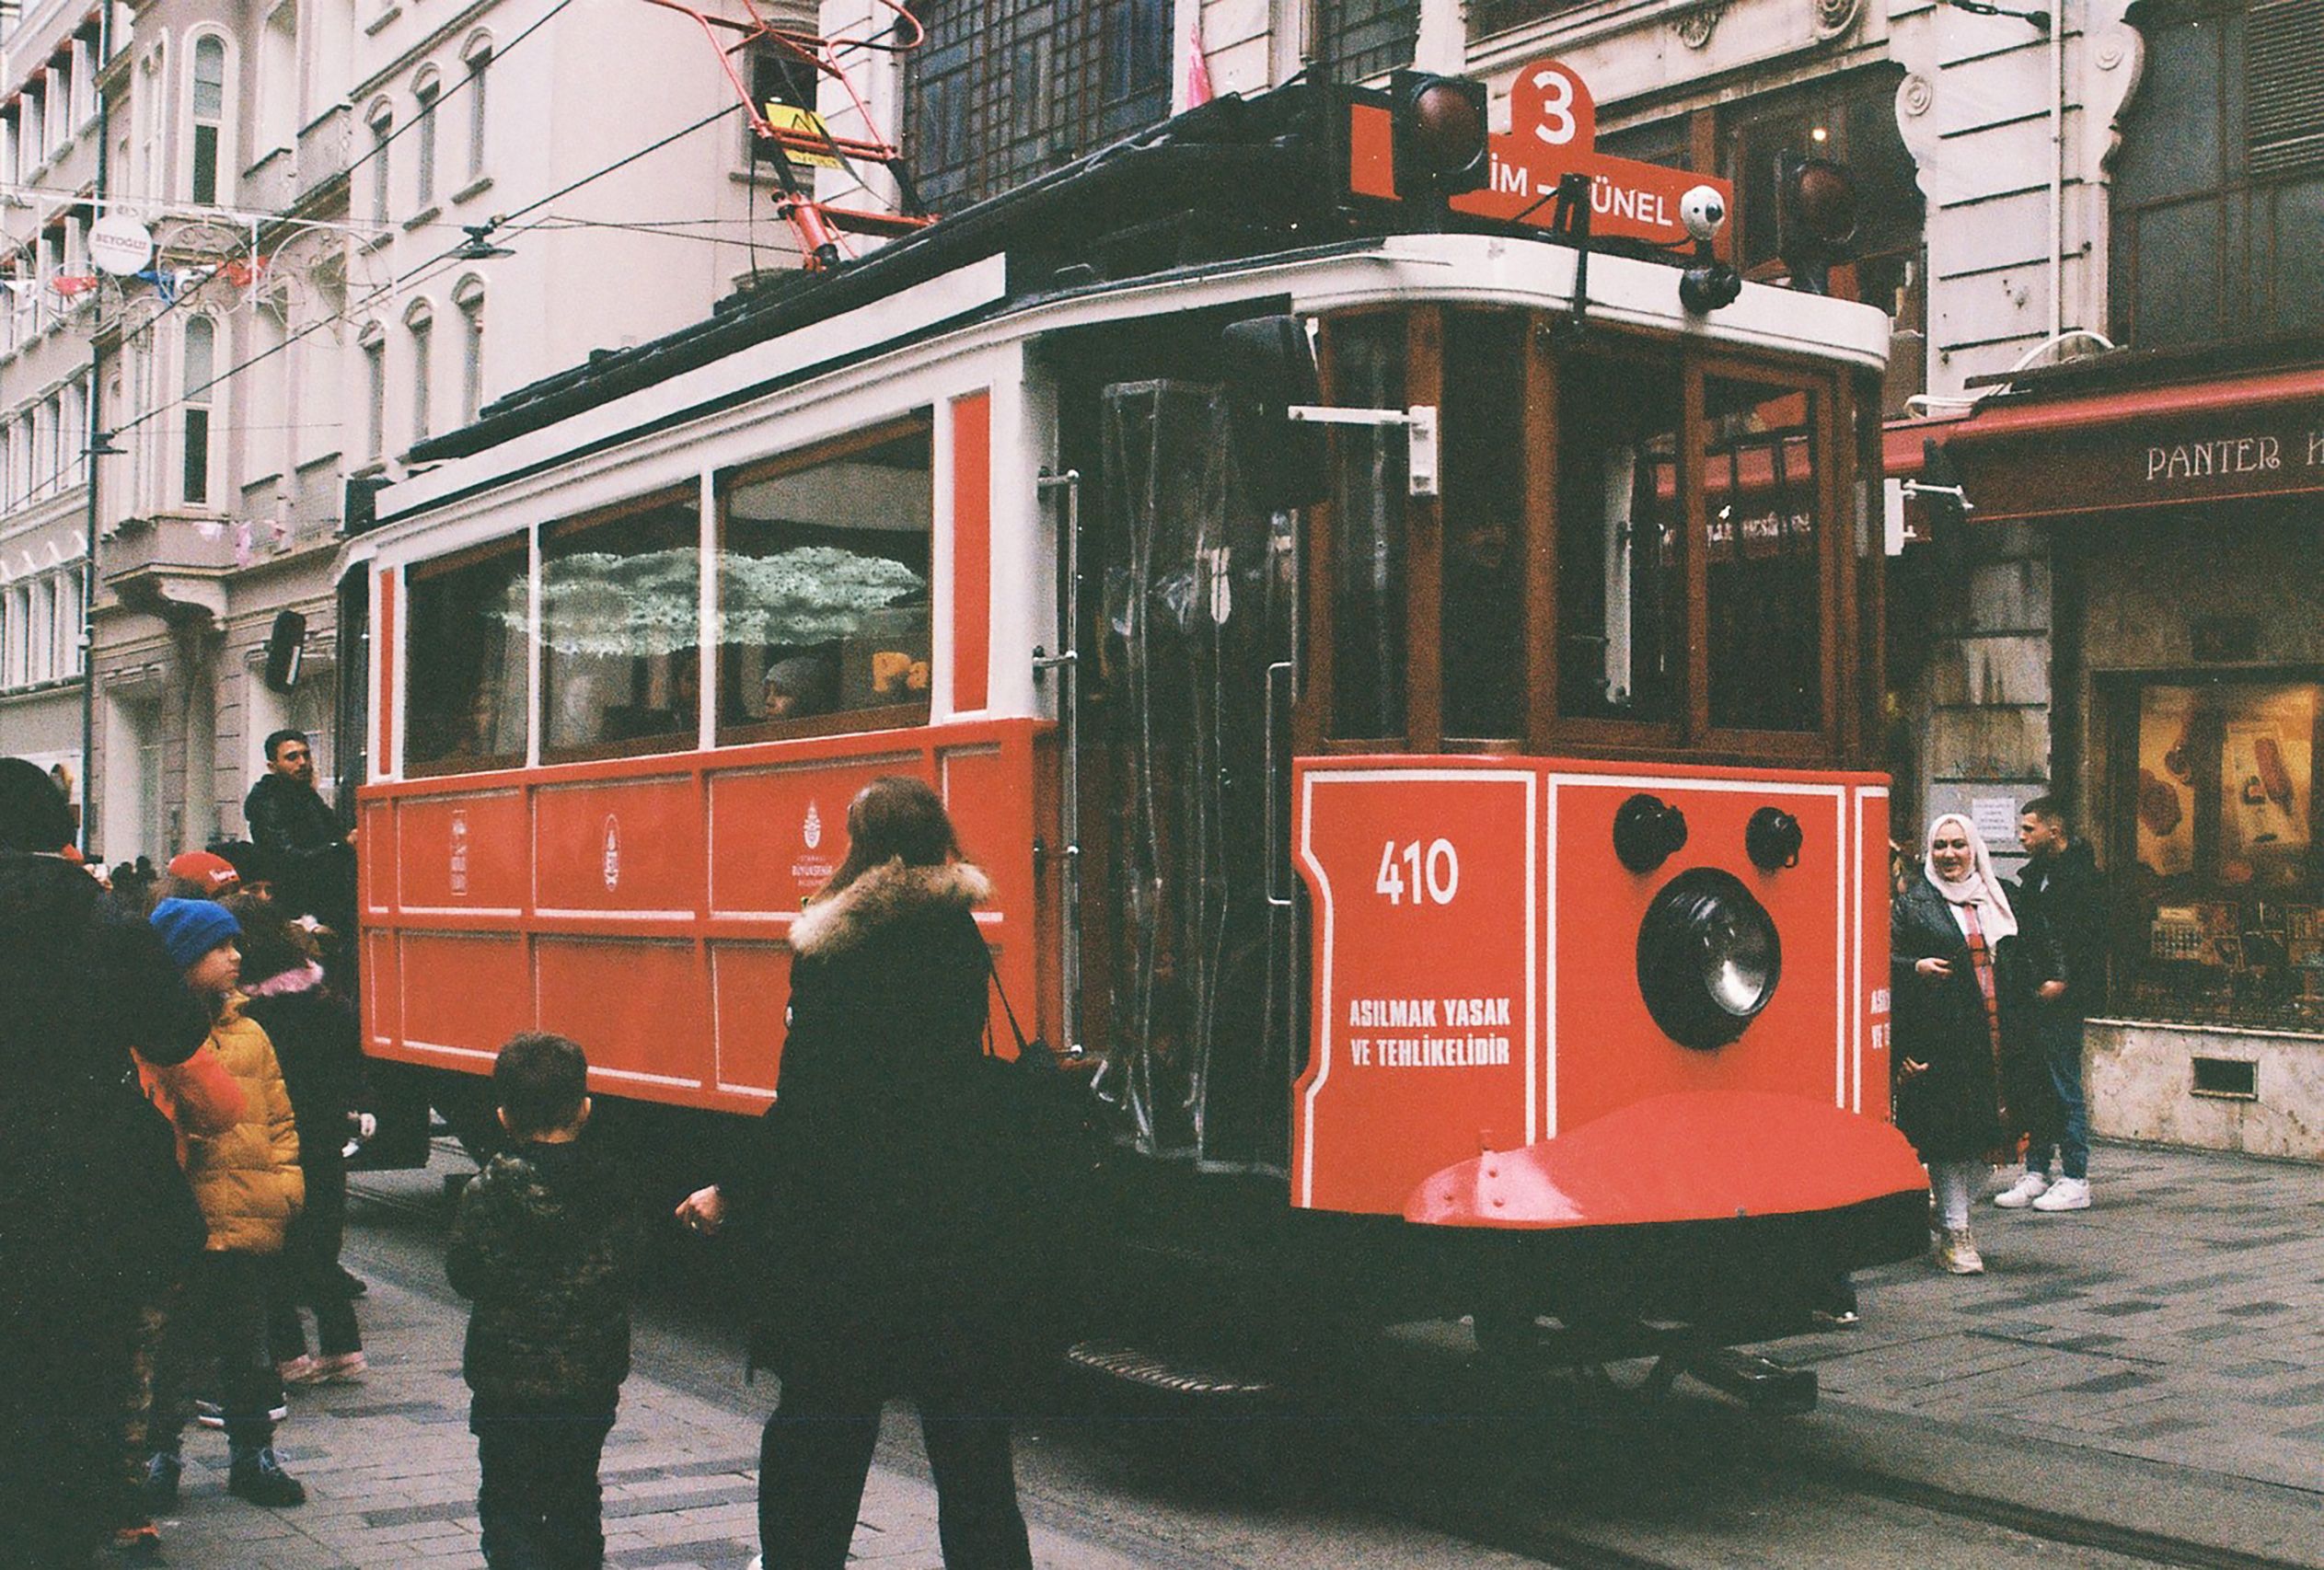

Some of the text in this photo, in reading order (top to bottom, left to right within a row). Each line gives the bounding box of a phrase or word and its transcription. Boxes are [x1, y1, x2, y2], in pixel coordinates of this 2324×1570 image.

[1532, 71, 1576, 144] 3
[1590, 175, 1673, 226] ÜNEL
[2146, 436, 2281, 480] PANTER
[1376, 838, 1459, 905] 410
[1349, 998, 1510, 1027] ASILMAK YASAK
[1350, 1033, 1509, 1067] VE TEHLİKELİDİR
